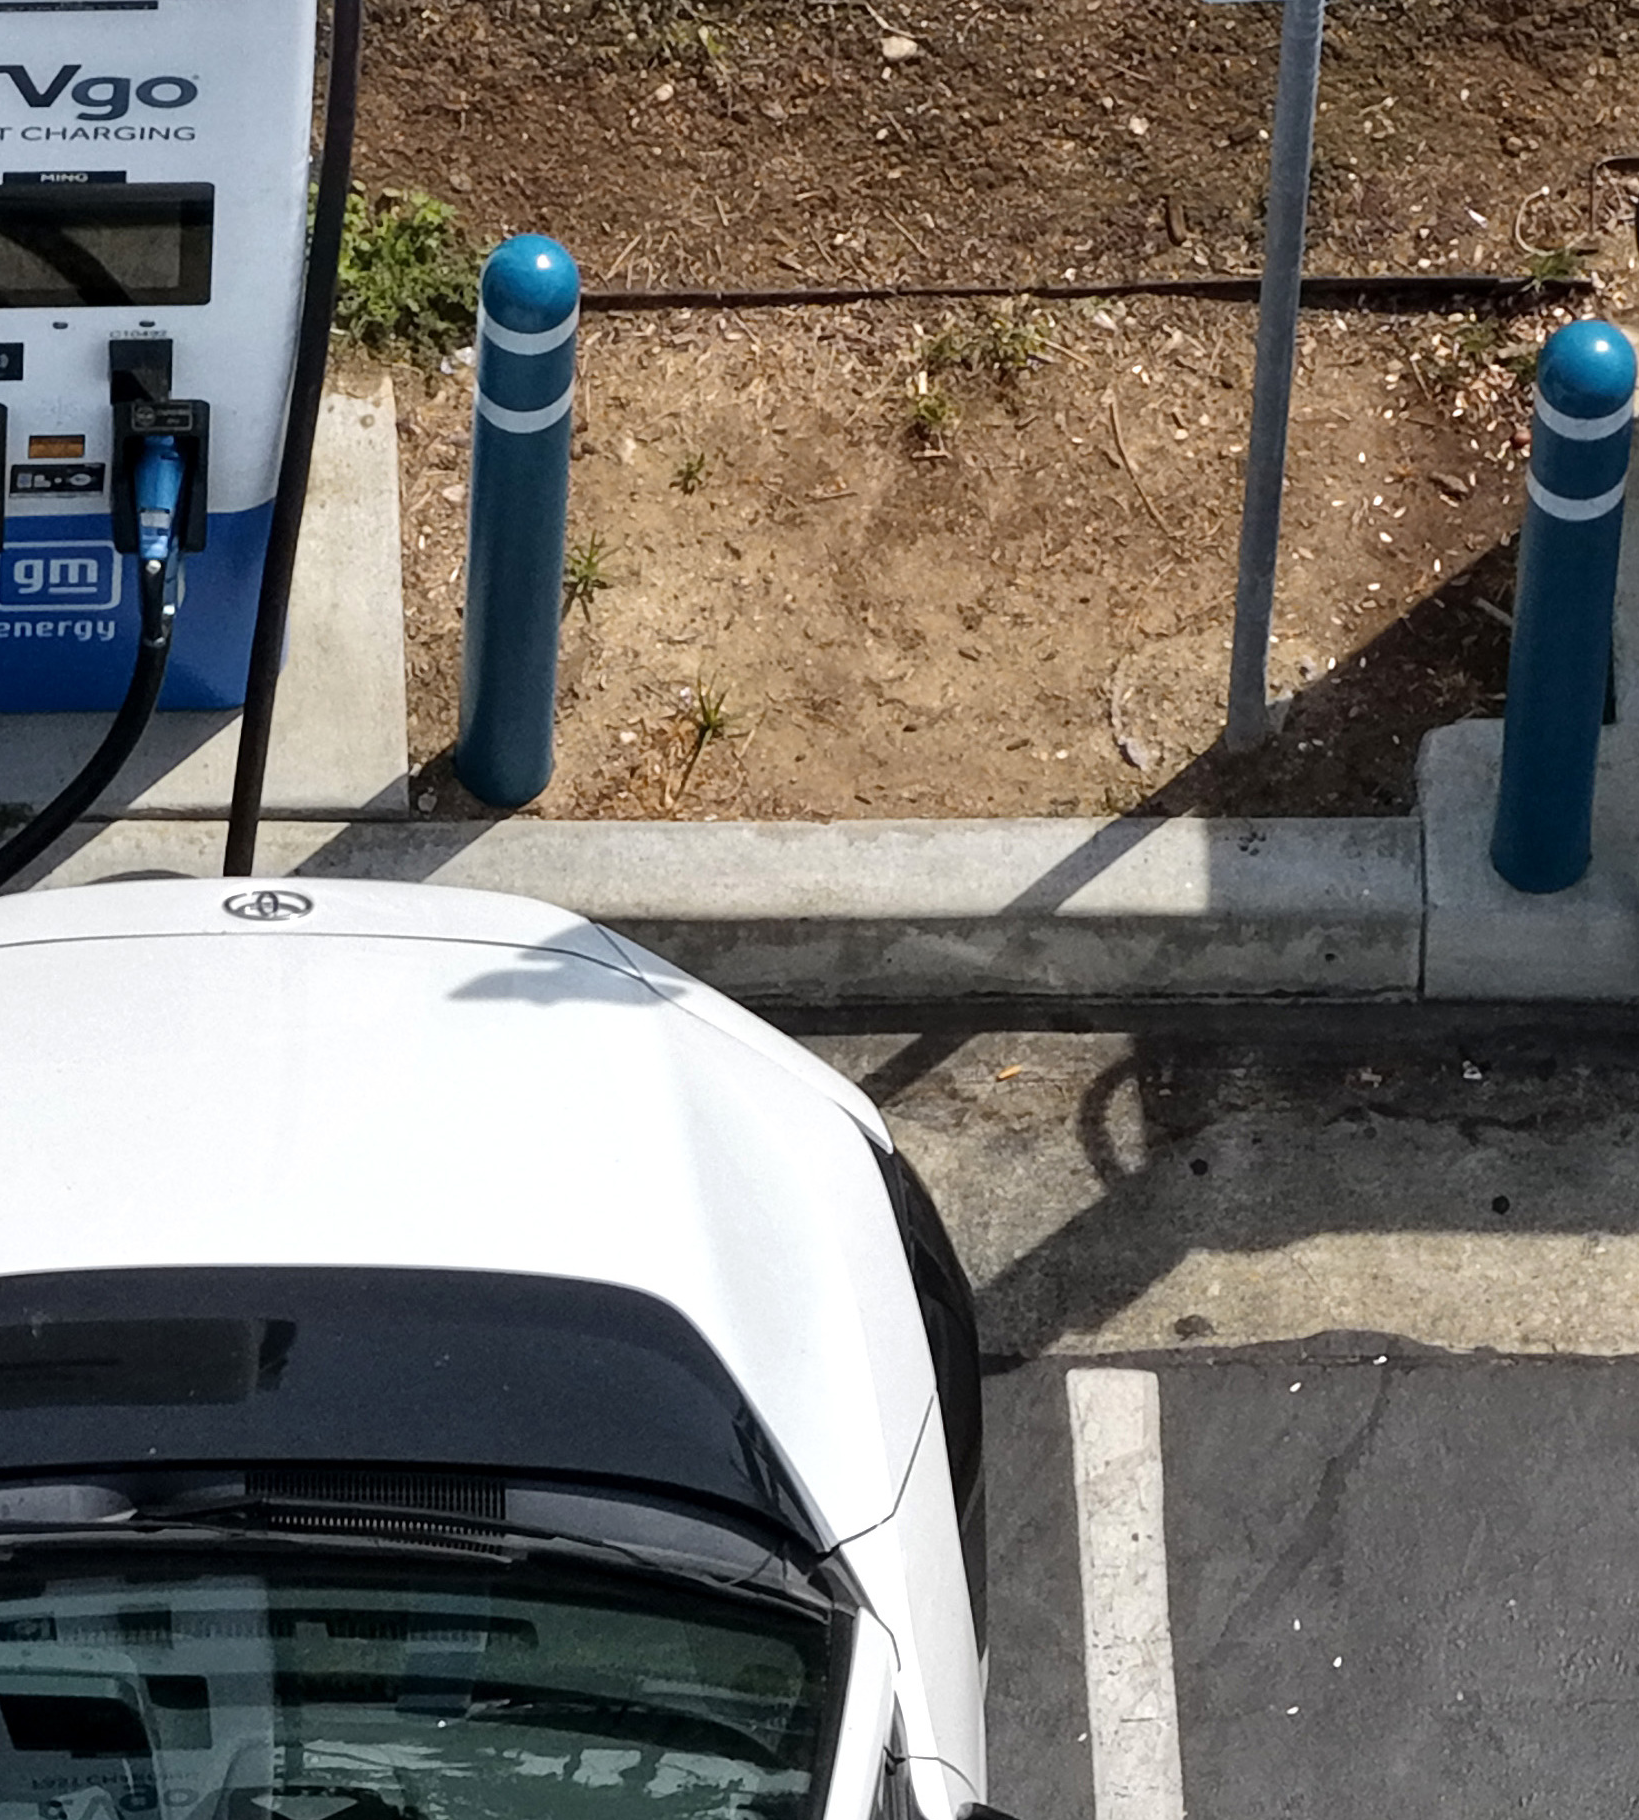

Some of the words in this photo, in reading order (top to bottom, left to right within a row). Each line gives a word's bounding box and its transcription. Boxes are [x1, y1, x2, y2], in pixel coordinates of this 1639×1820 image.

[21, 126, 196, 142] CHARGING
[40, 173, 89, 182] MING
[12, 556, 99, 594] gm
